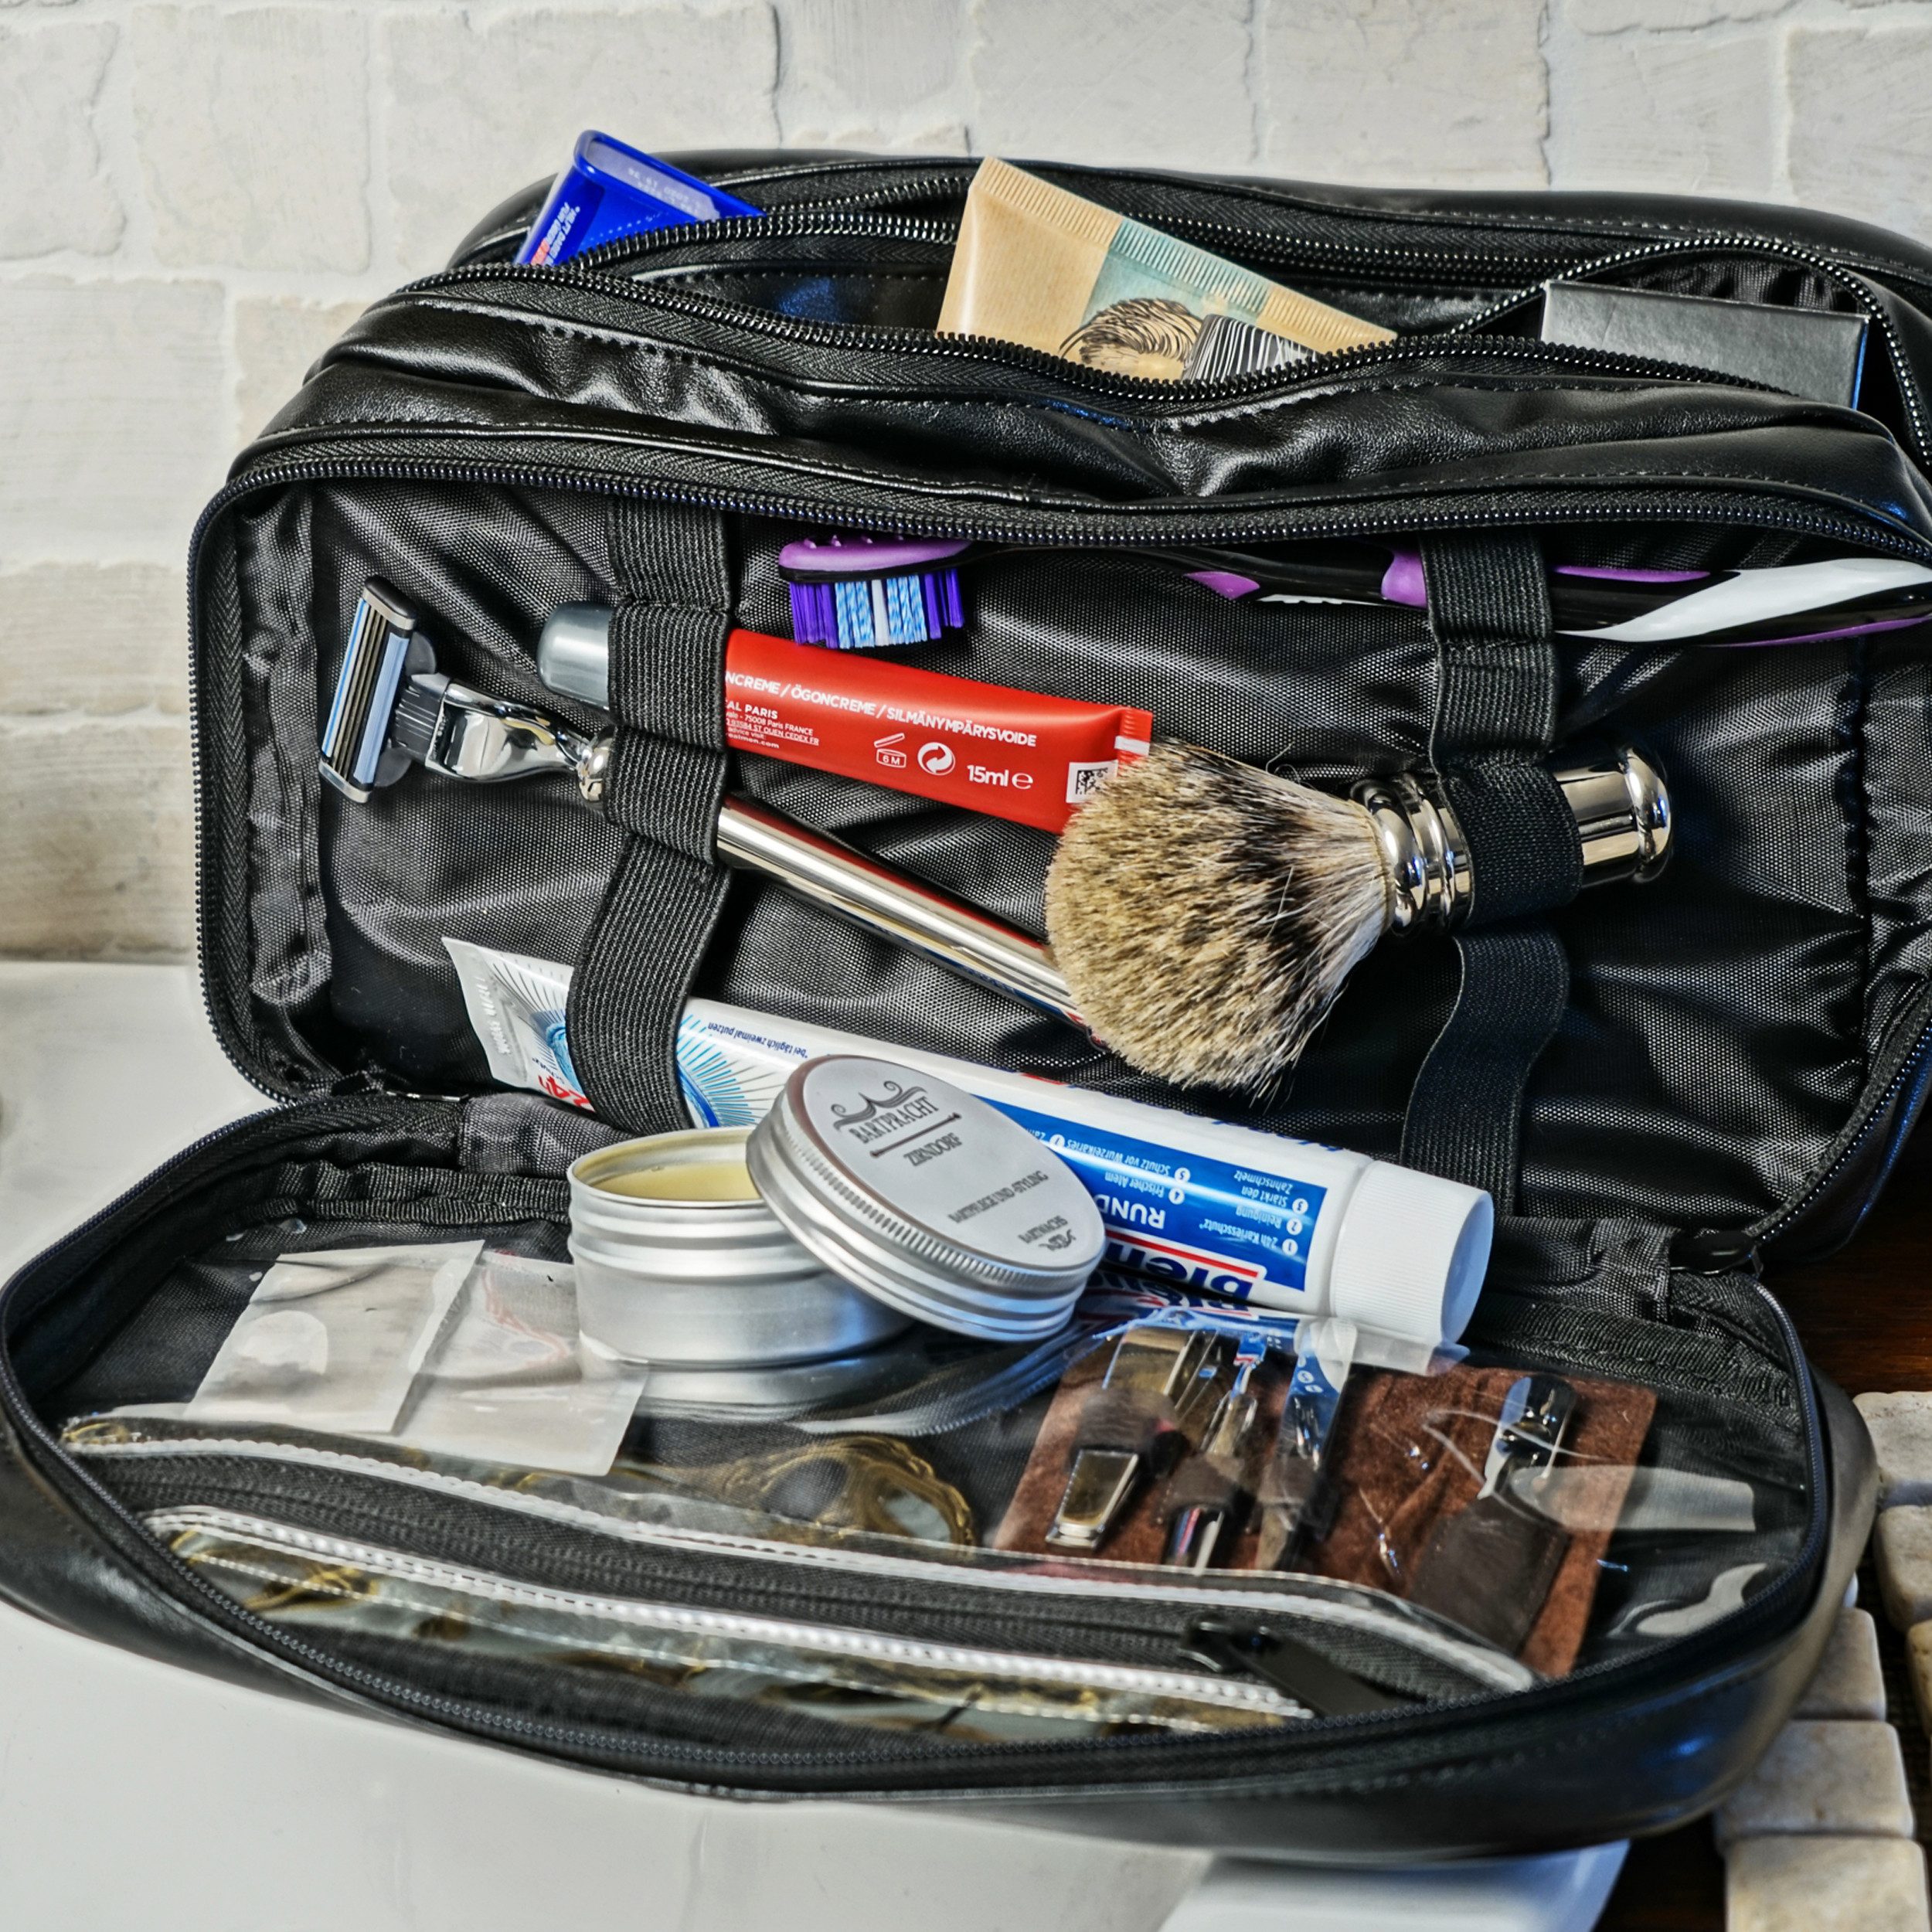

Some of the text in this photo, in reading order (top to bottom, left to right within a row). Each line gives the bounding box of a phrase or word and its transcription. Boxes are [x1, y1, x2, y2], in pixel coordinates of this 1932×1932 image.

[725, 699, 778, 719] AL PARIS
[791, 684, 877, 716] ÖGONCREME
[886, 707, 1037, 747] SILMÄNYMPÄRYSVOIDE
[745, 714, 767, 726] 75008
[767, 719, 784, 729] Paris
[785, 723, 813, 736] FRANCE
[726, 733, 779, 749] ealmen.com
[785, 730, 808, 743] CEDEX
[810, 736, 819, 746] FR
[967, 764, 1009, 787] 15ml
[707, 1022, 735, 1036] putzen
[734, 1030, 767, 1046] zweimal
[767, 1039, 793, 1053] täglich
[849, 1096, 939, 1144] BARTPRACHT
[903, 1132, 962, 1166] ZIRNDORF
[1066, 1139, 1123, 1162] Wurzelkaries
[1124, 1155, 1139, 1167] vor
[1140, 1160, 1171, 1177] Schutz
[1104, 1171, 1130, 1188] Atem
[1129, 1178, 1165, 1198] Frischer
[1234, 1170, 1293, 1195] Zahnschmelz
[1241, 1185, 1260, 1199] den
[1236, 1206, 1283, 1230] Reinigung
